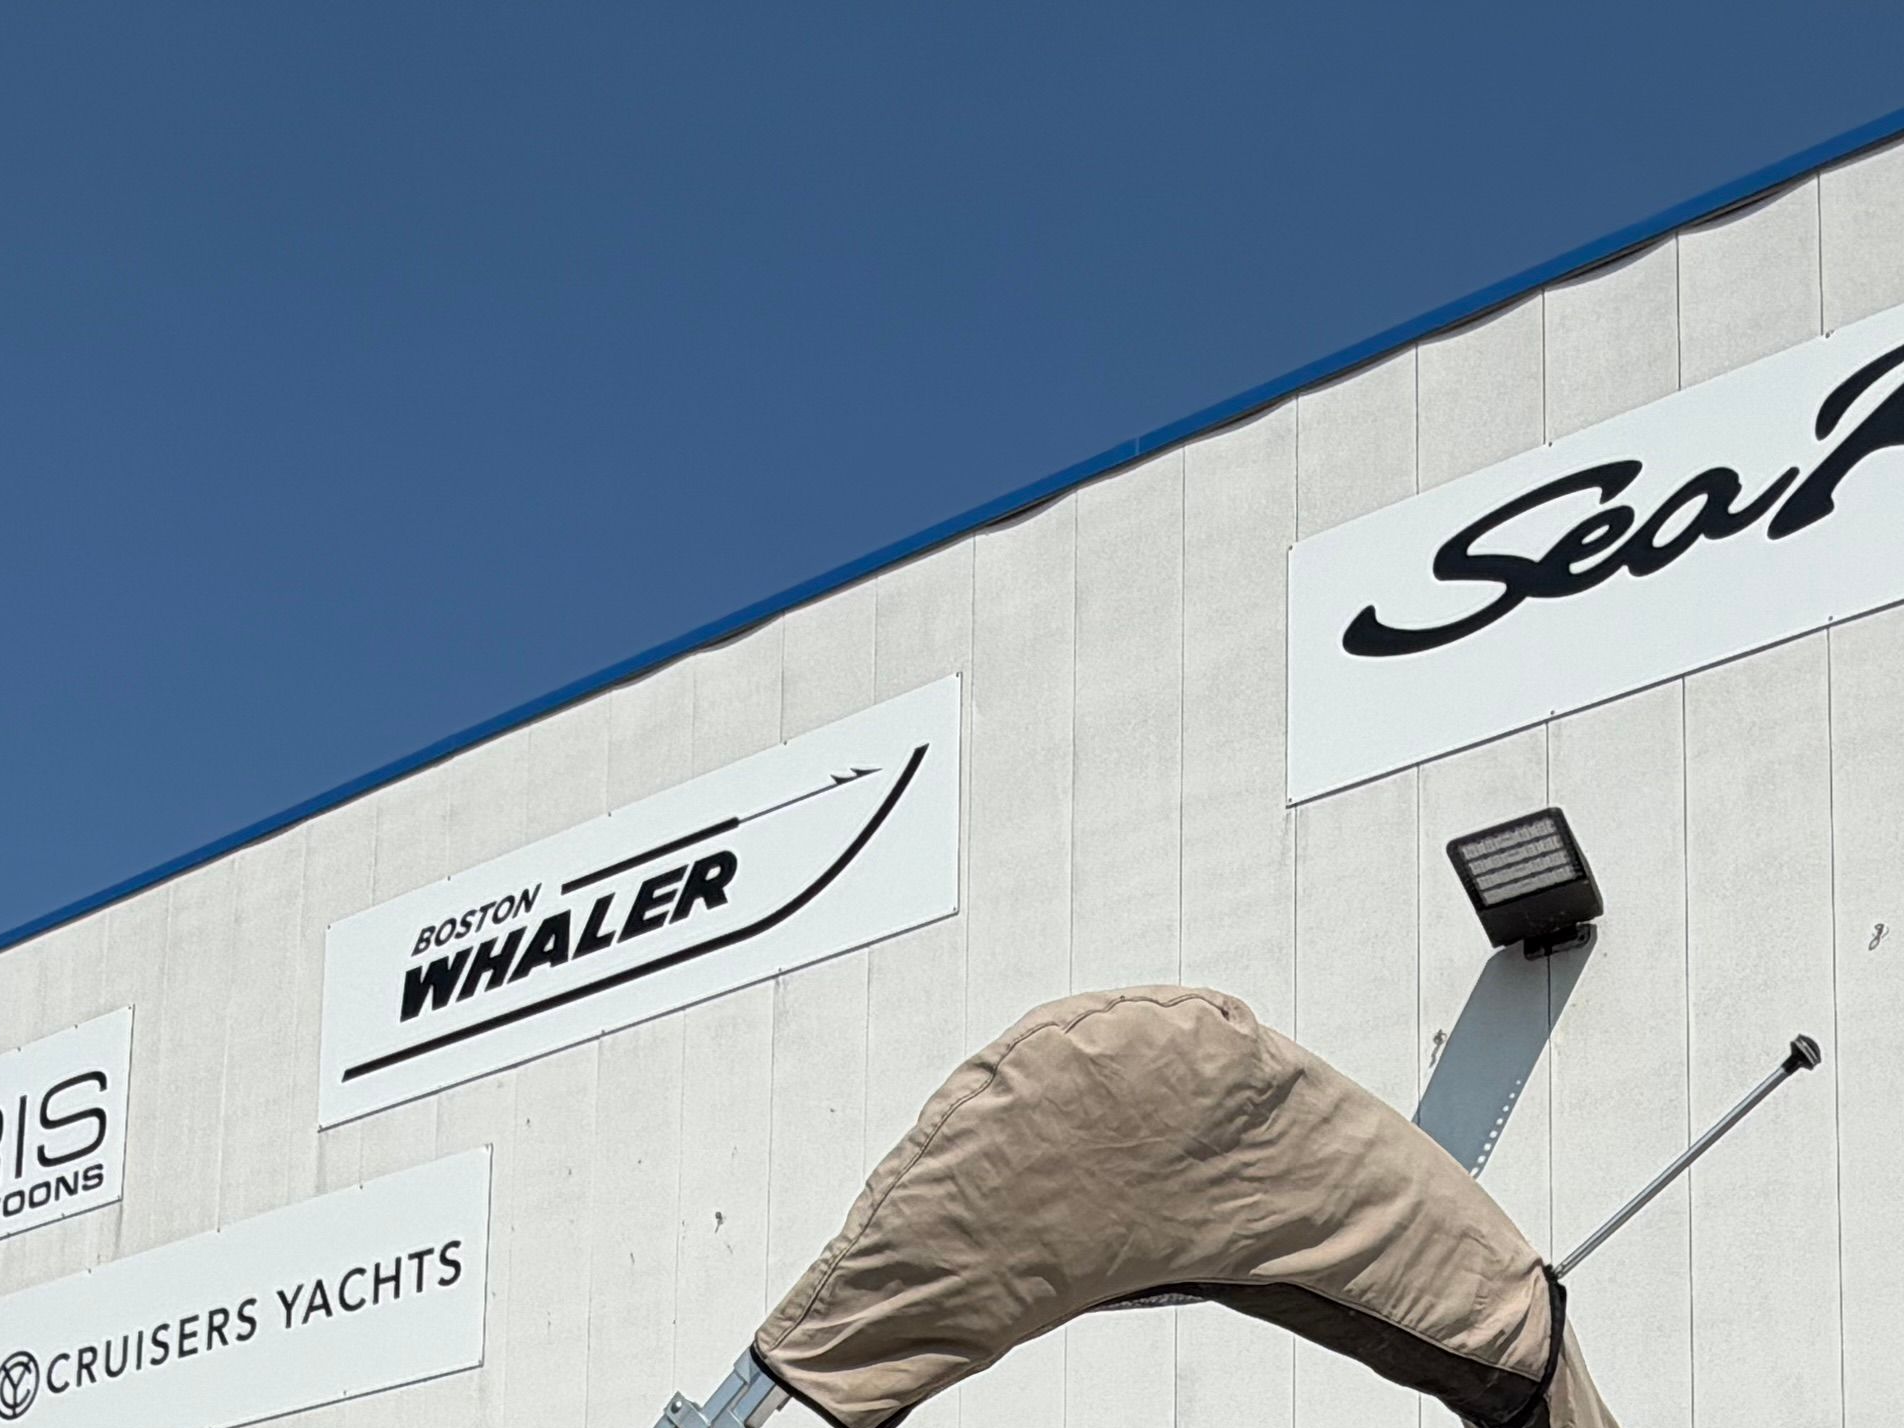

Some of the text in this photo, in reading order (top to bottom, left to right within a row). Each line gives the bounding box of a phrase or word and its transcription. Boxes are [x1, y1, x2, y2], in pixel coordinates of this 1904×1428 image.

[1341, 459, 1798, 658] Sea
[399, 849, 739, 1022] WHALER
[410, 882, 542, 956] BOSTON
[45, 1297, 258, 1394] CRUISERS
[276, 1239, 463, 1329] YACHTS
